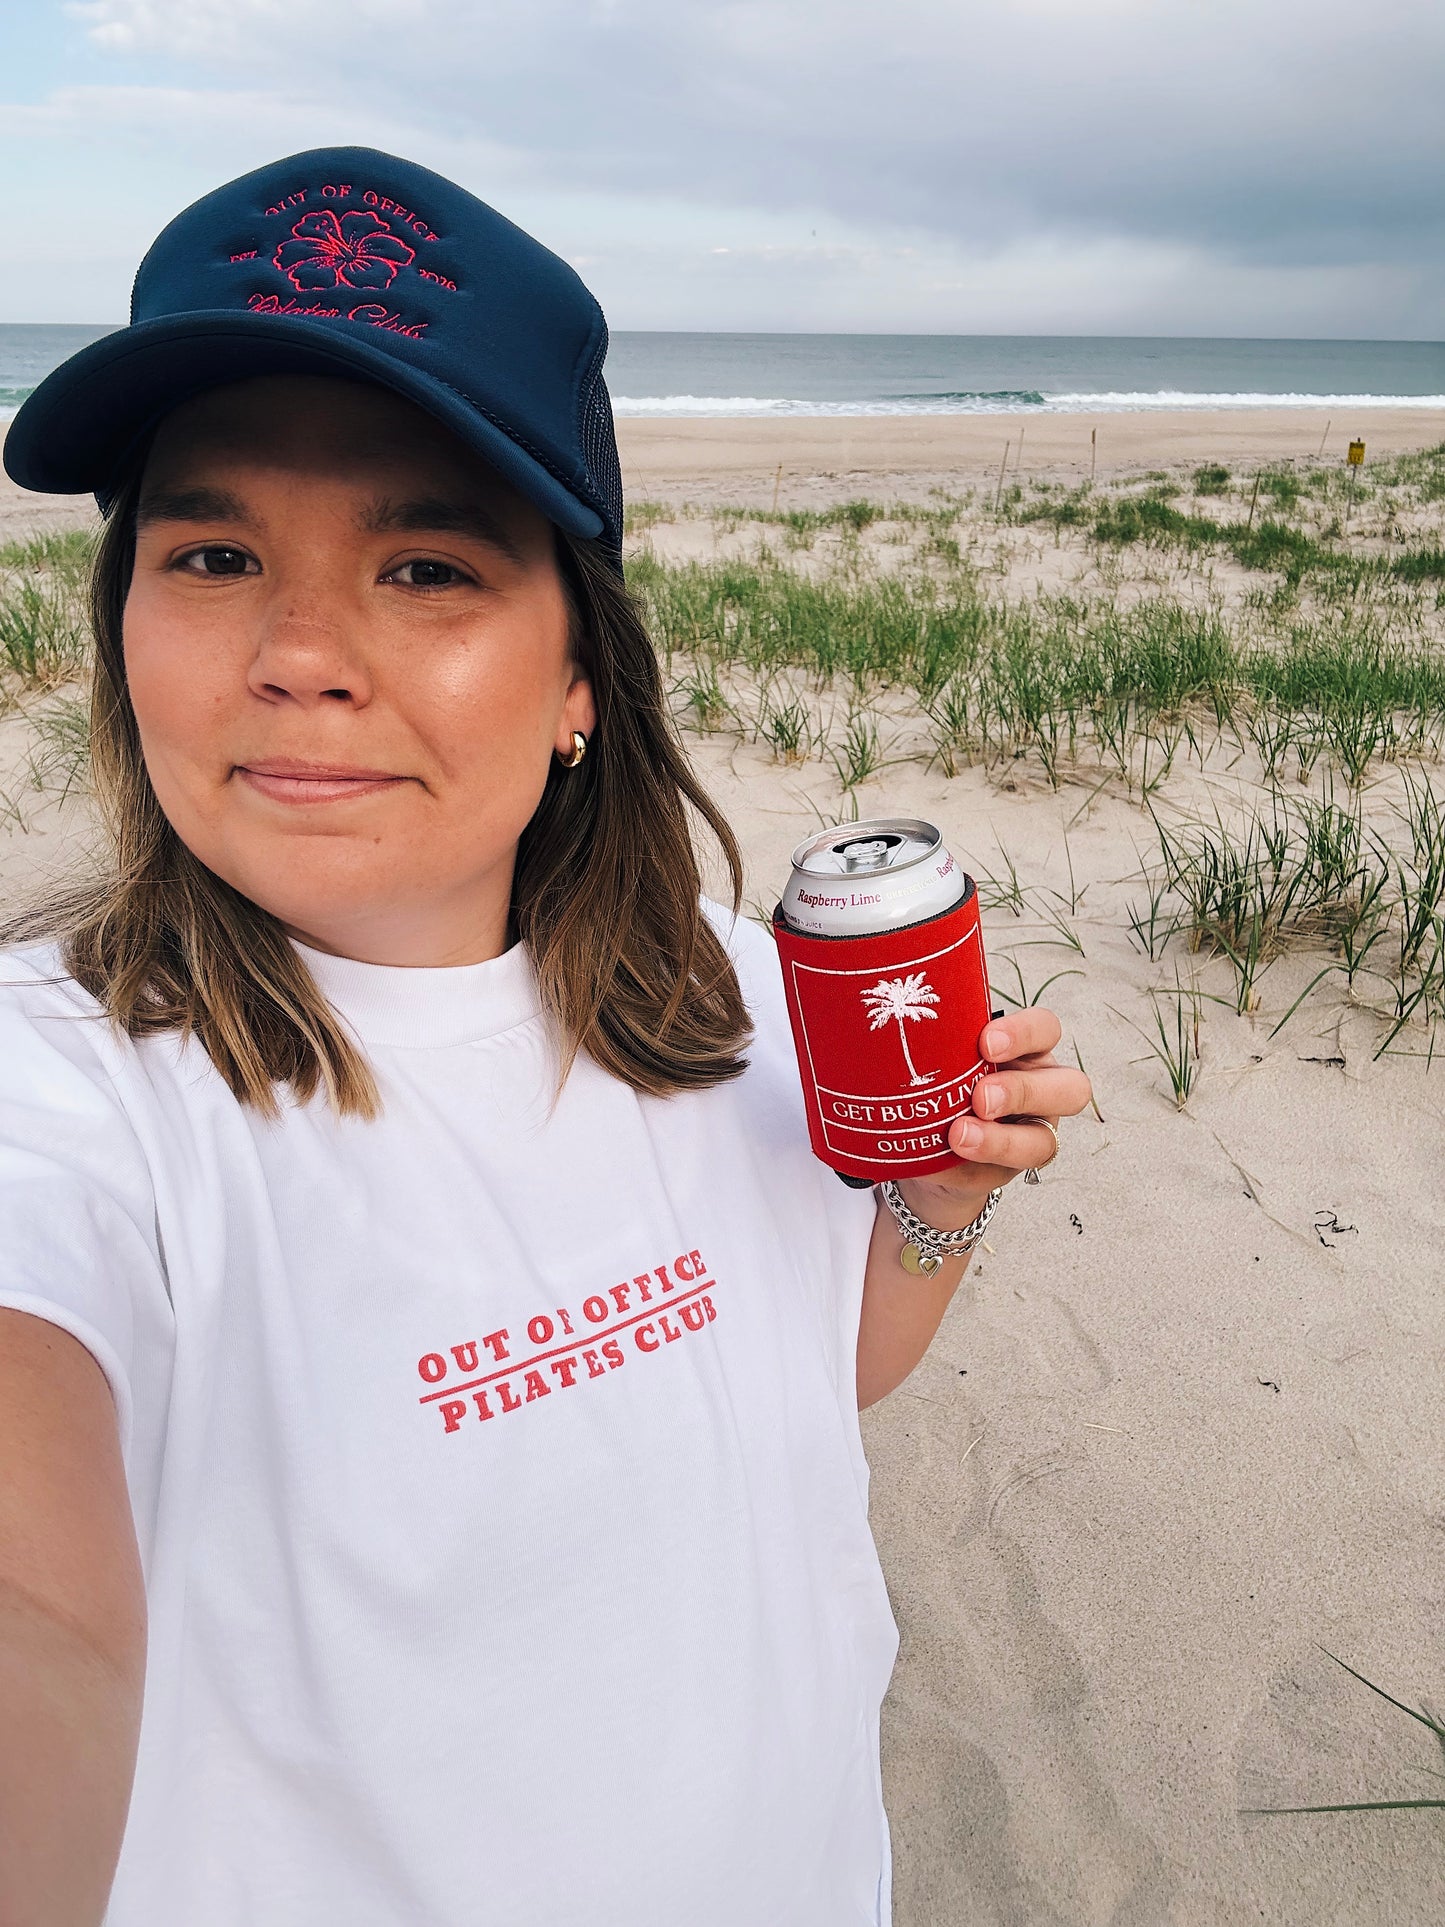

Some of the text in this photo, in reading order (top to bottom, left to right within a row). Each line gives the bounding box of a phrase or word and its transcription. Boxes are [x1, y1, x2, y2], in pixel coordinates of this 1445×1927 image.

[322, 184, 352, 198] OF
[797, 888, 882, 910] Raspberry Lime
[832, 1101, 875, 1122] GET
[881, 1096, 942, 1122] BUSY
[877, 1132, 943, 1153] OUTER
[417, 1249, 708, 1384] OUT OF OFFICE
[438, 1295, 718, 1434] PILATES CLUB
